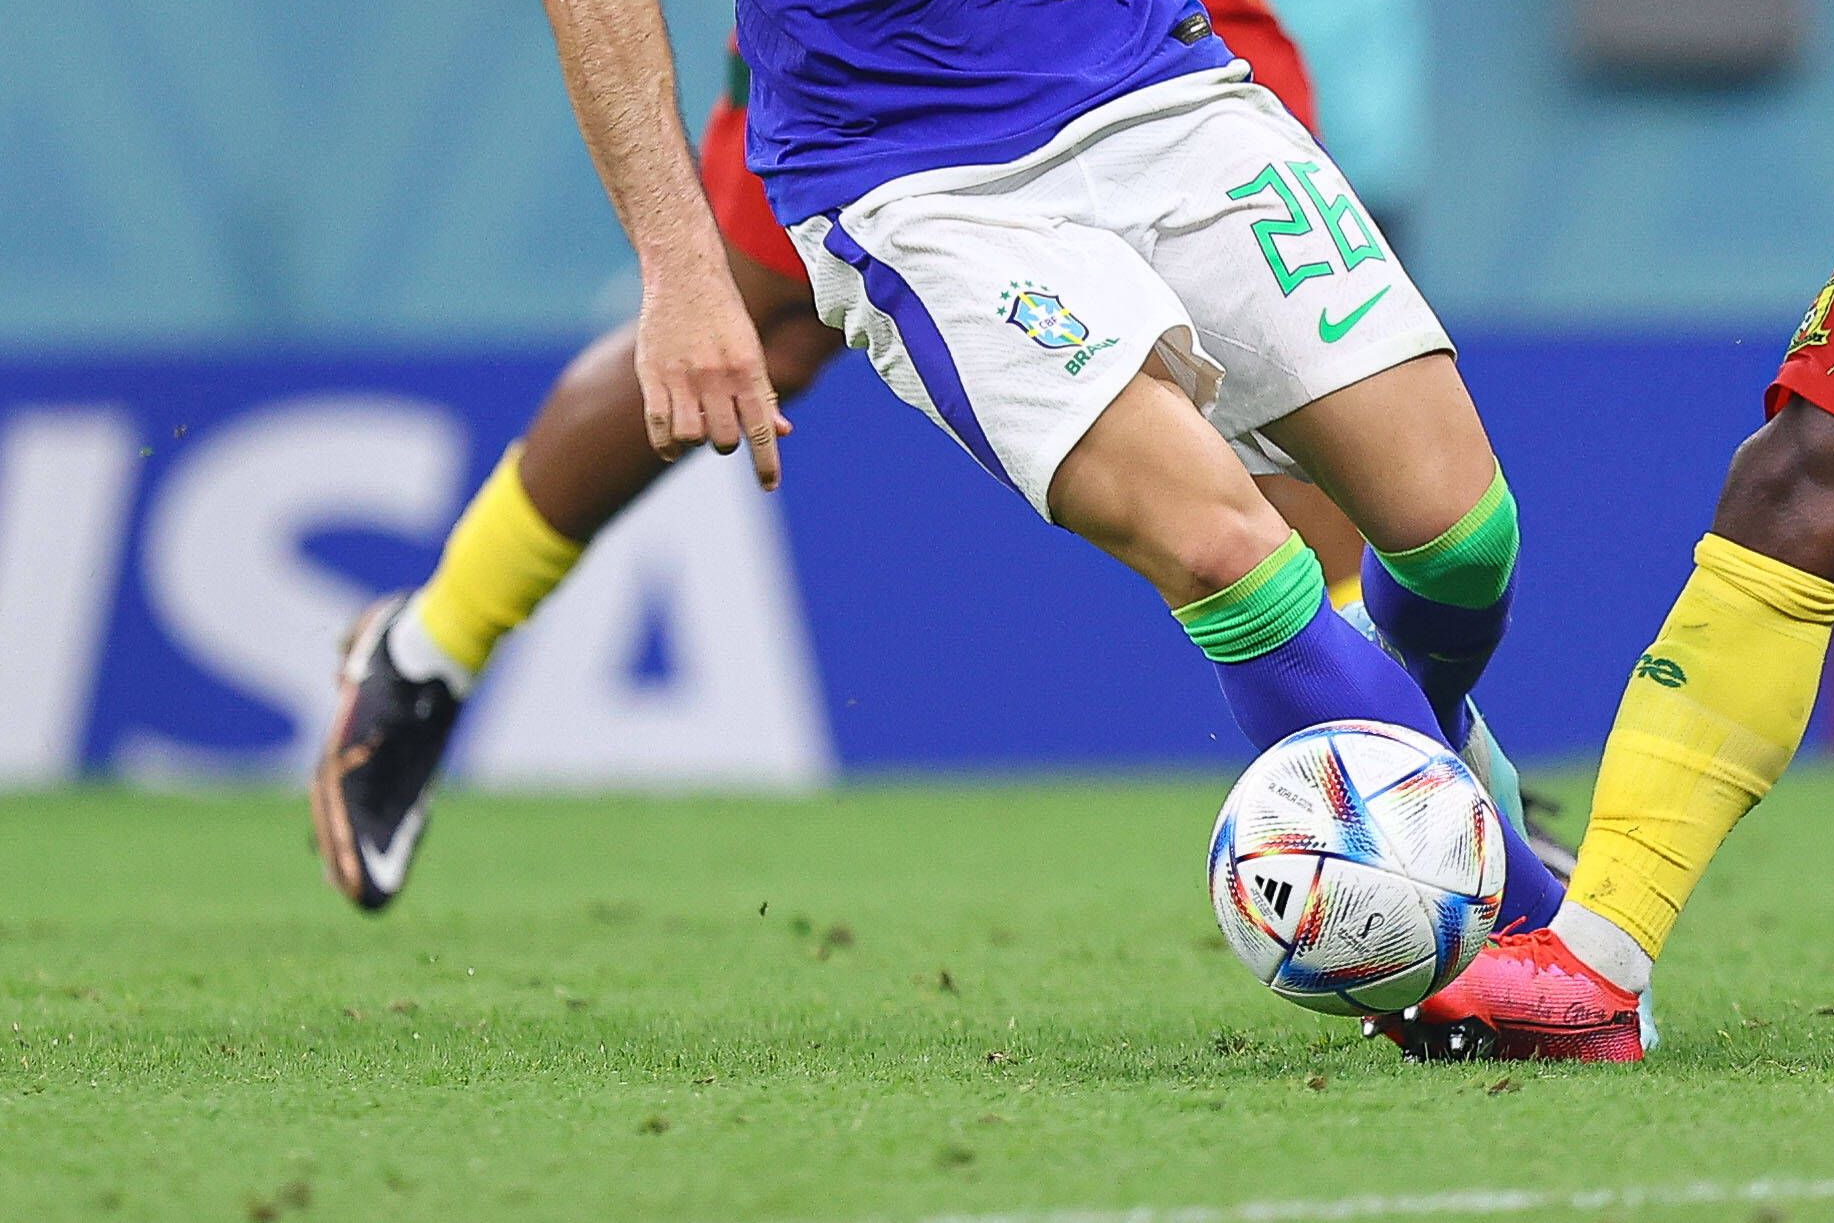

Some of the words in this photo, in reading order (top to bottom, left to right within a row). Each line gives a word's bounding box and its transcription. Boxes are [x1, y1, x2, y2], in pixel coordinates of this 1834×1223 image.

[1226, 160, 1387, 298] 26
[1039, 315, 1058, 330] CBF
[0, 392, 843, 792] ISA
